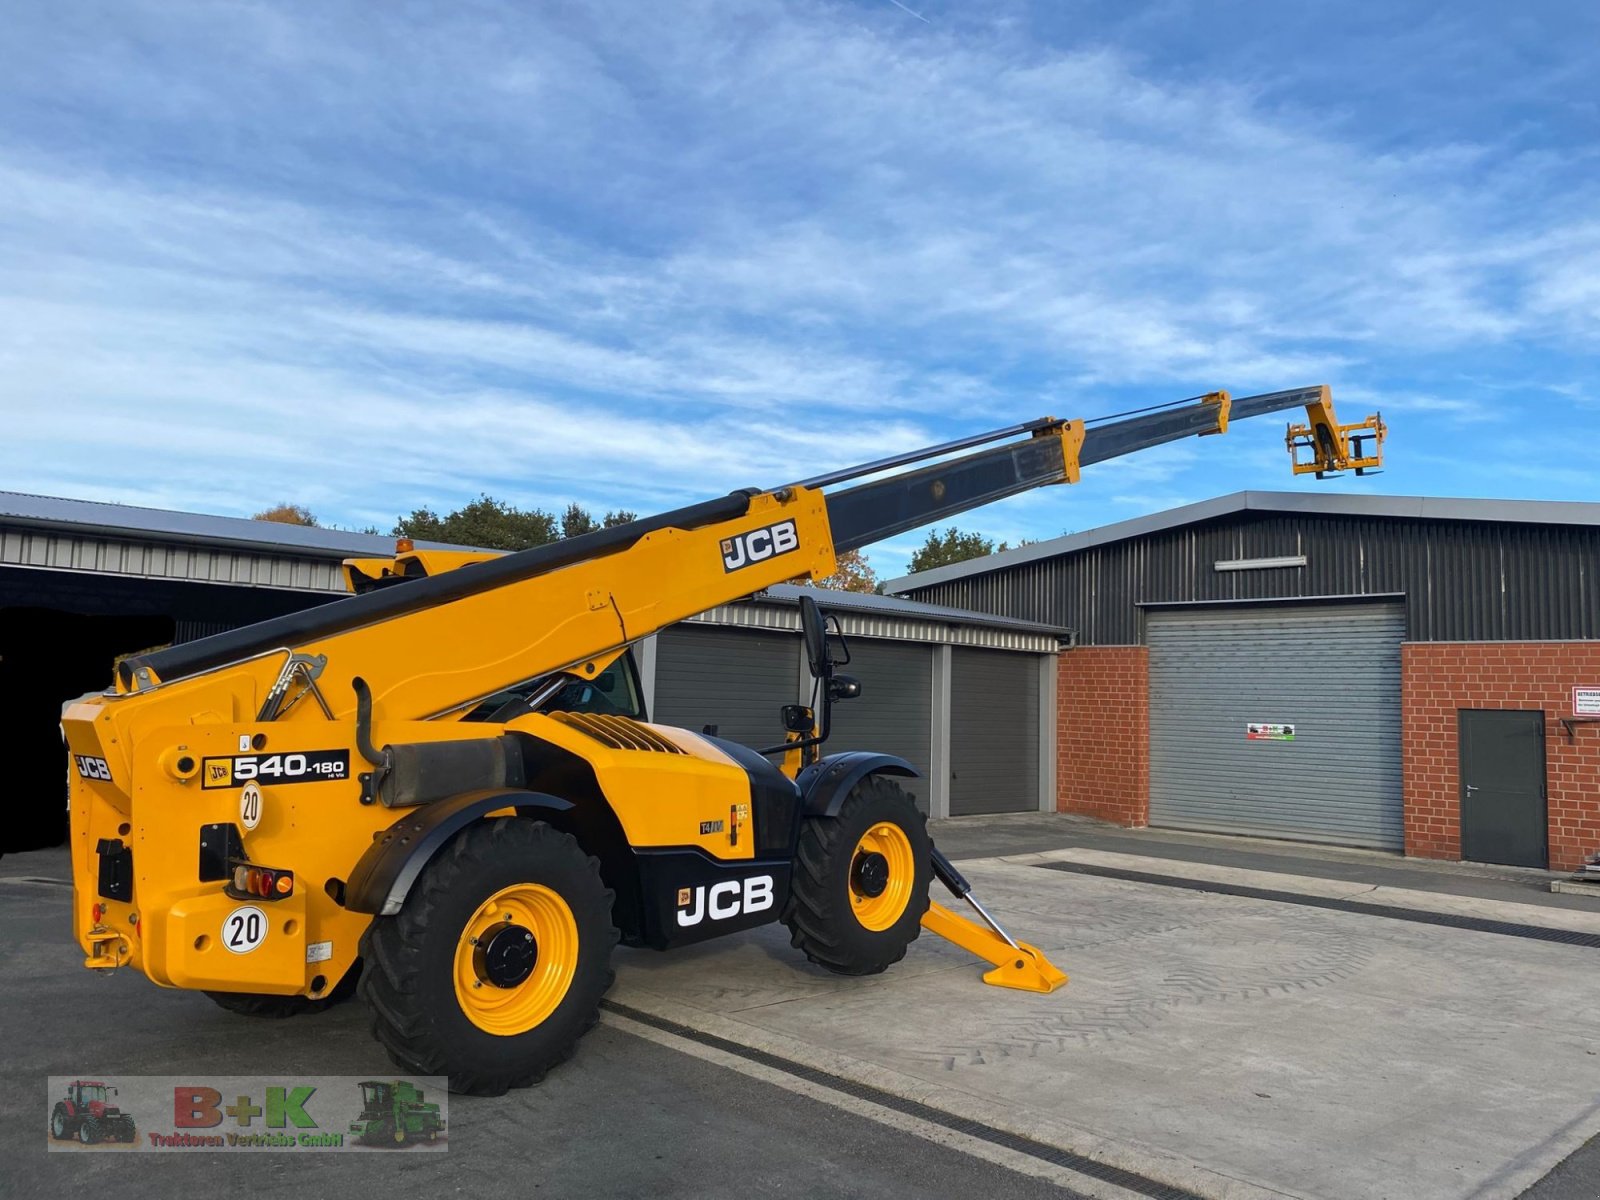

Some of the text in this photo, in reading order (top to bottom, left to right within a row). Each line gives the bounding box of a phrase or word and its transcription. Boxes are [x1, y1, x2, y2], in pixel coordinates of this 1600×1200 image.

[724, 522, 797, 569] JCB
[78, 756, 112, 780] JCB
[209, 766, 228, 779] JCB
[243, 791, 258, 820] 20
[677, 875, 774, 927] JCB
[230, 913, 260, 946] 20
